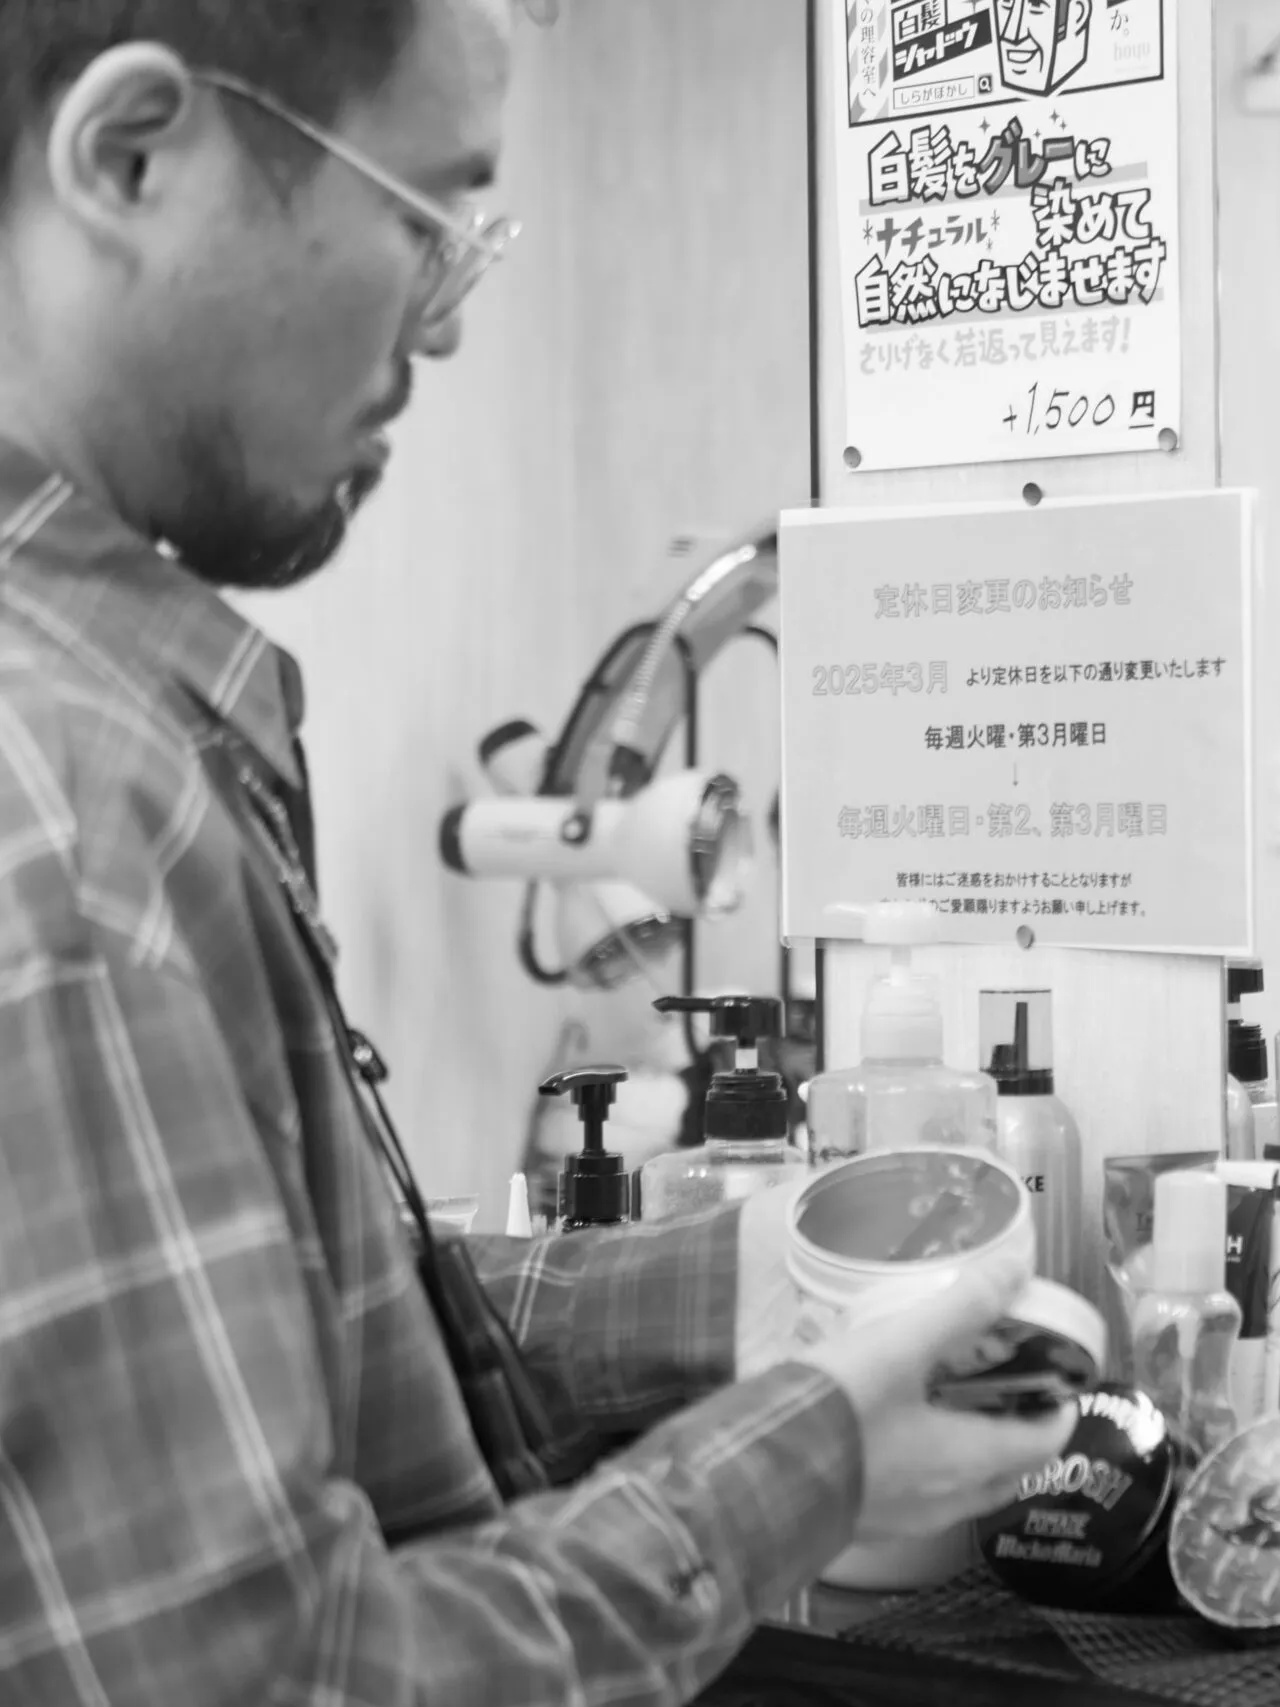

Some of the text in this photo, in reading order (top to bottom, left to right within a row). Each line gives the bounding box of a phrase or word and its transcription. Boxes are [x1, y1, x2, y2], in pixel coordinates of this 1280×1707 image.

[899, 0, 942, 40] 白髪
[860, 0, 876, 97] の理容室へ
[894, 20, 979, 74] シャドウ
[900, 83, 968, 105] しらがぼかし
[868, 116, 1112, 207] 白髪をグレーに
[876, 215, 989, 258] ナチュラル
[1030, 176, 1155, 249] 染めて
[854, 235, 1167, 329] 自然になじませます
[873, 573, 1134, 619] 定休日変更のお知らせ
[812, 656, 1227, 696] 2025年3月 より定休日を以下の通り変更いたします
